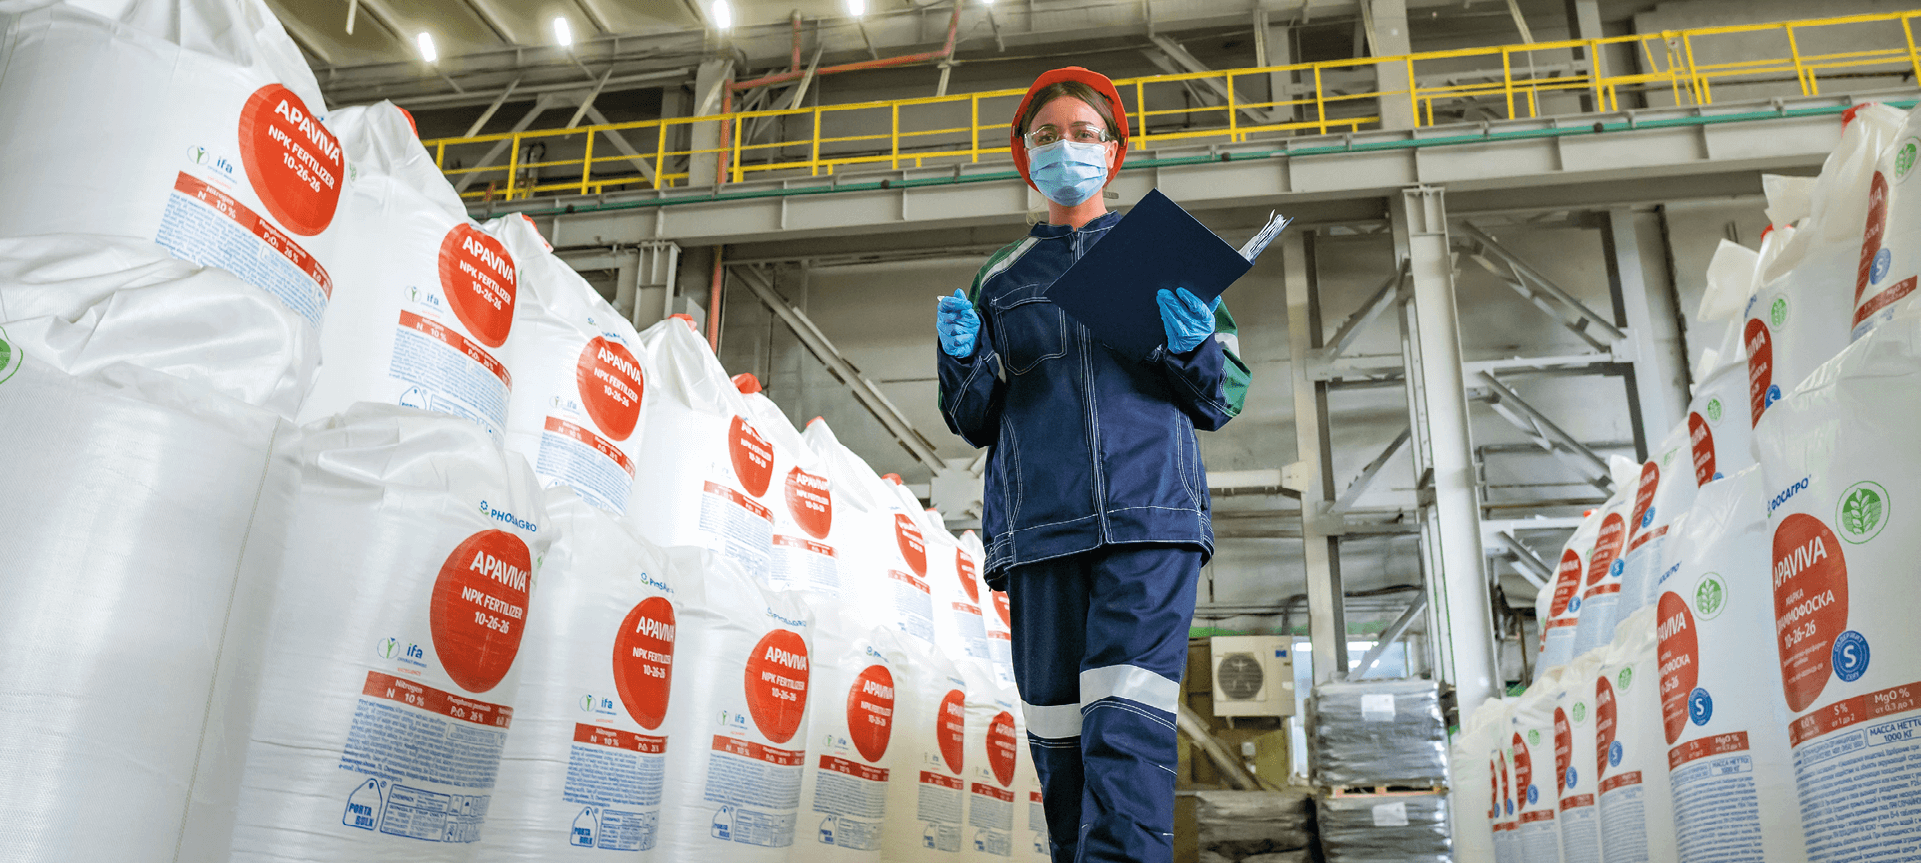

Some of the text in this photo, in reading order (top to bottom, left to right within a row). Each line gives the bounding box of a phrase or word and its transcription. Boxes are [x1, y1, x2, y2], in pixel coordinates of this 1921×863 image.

[274, 98, 341, 167] APAVIVA
[217, 156, 233, 174] ifa
[268, 124, 335, 190] NPK FERTILIZER
[283, 152, 321, 193] 10-26-26
[197, 191, 237, 220] N 10 %
[462, 236, 514, 285] APAVIVA
[459, 259, 512, 306] NPK FERTILIZER
[427, 293, 439, 305] ifa
[472, 280, 502, 310] 10-26-26
[597, 347, 641, 386] APAVIVA
[594, 367, 638, 404] NPK FERTILIZER
[603, 384, 630, 408] 10-26-26
[1772, 477, 1809, 511] ФОСАГРО
[469, 550, 527, 593] APAVIVA
[1774, 536, 1828, 591] APAVIVA
[461, 585, 523, 620] NPK FERTILIZER
[474, 611, 510, 634] 10-26-26
[635, 615, 675, 643] APAVIVA
[1784, 619, 1816, 650] 10-26-26
[406, 643, 424, 659] ifa
[632, 646, 649, 660] NPK
[764, 646, 807, 671] APAVIVA
[1843, 644, 1857, 668] S
[395, 679, 423, 694] Nitrogen
[762, 671, 777, 684] NPK
[386, 687, 425, 706] N 10 %
[862, 679, 894, 700] APAVIVA
[1874, 688, 1910, 704] MgO %
[600, 697, 613, 710] ifa
[1695, 698, 1704, 716] S
[1834, 703, 1848, 716] S %
[1875, 706, 1883, 714] от
[1897, 701, 1907, 711] до
[1850, 713, 1855, 721] 2
[590, 735, 597, 743] N
[1870, 725, 1896, 736] МАССА
[1884, 729, 1914, 743] 1000 КГ
[349, 803, 373, 817] PORTA
[355, 815, 374, 827] BULK
